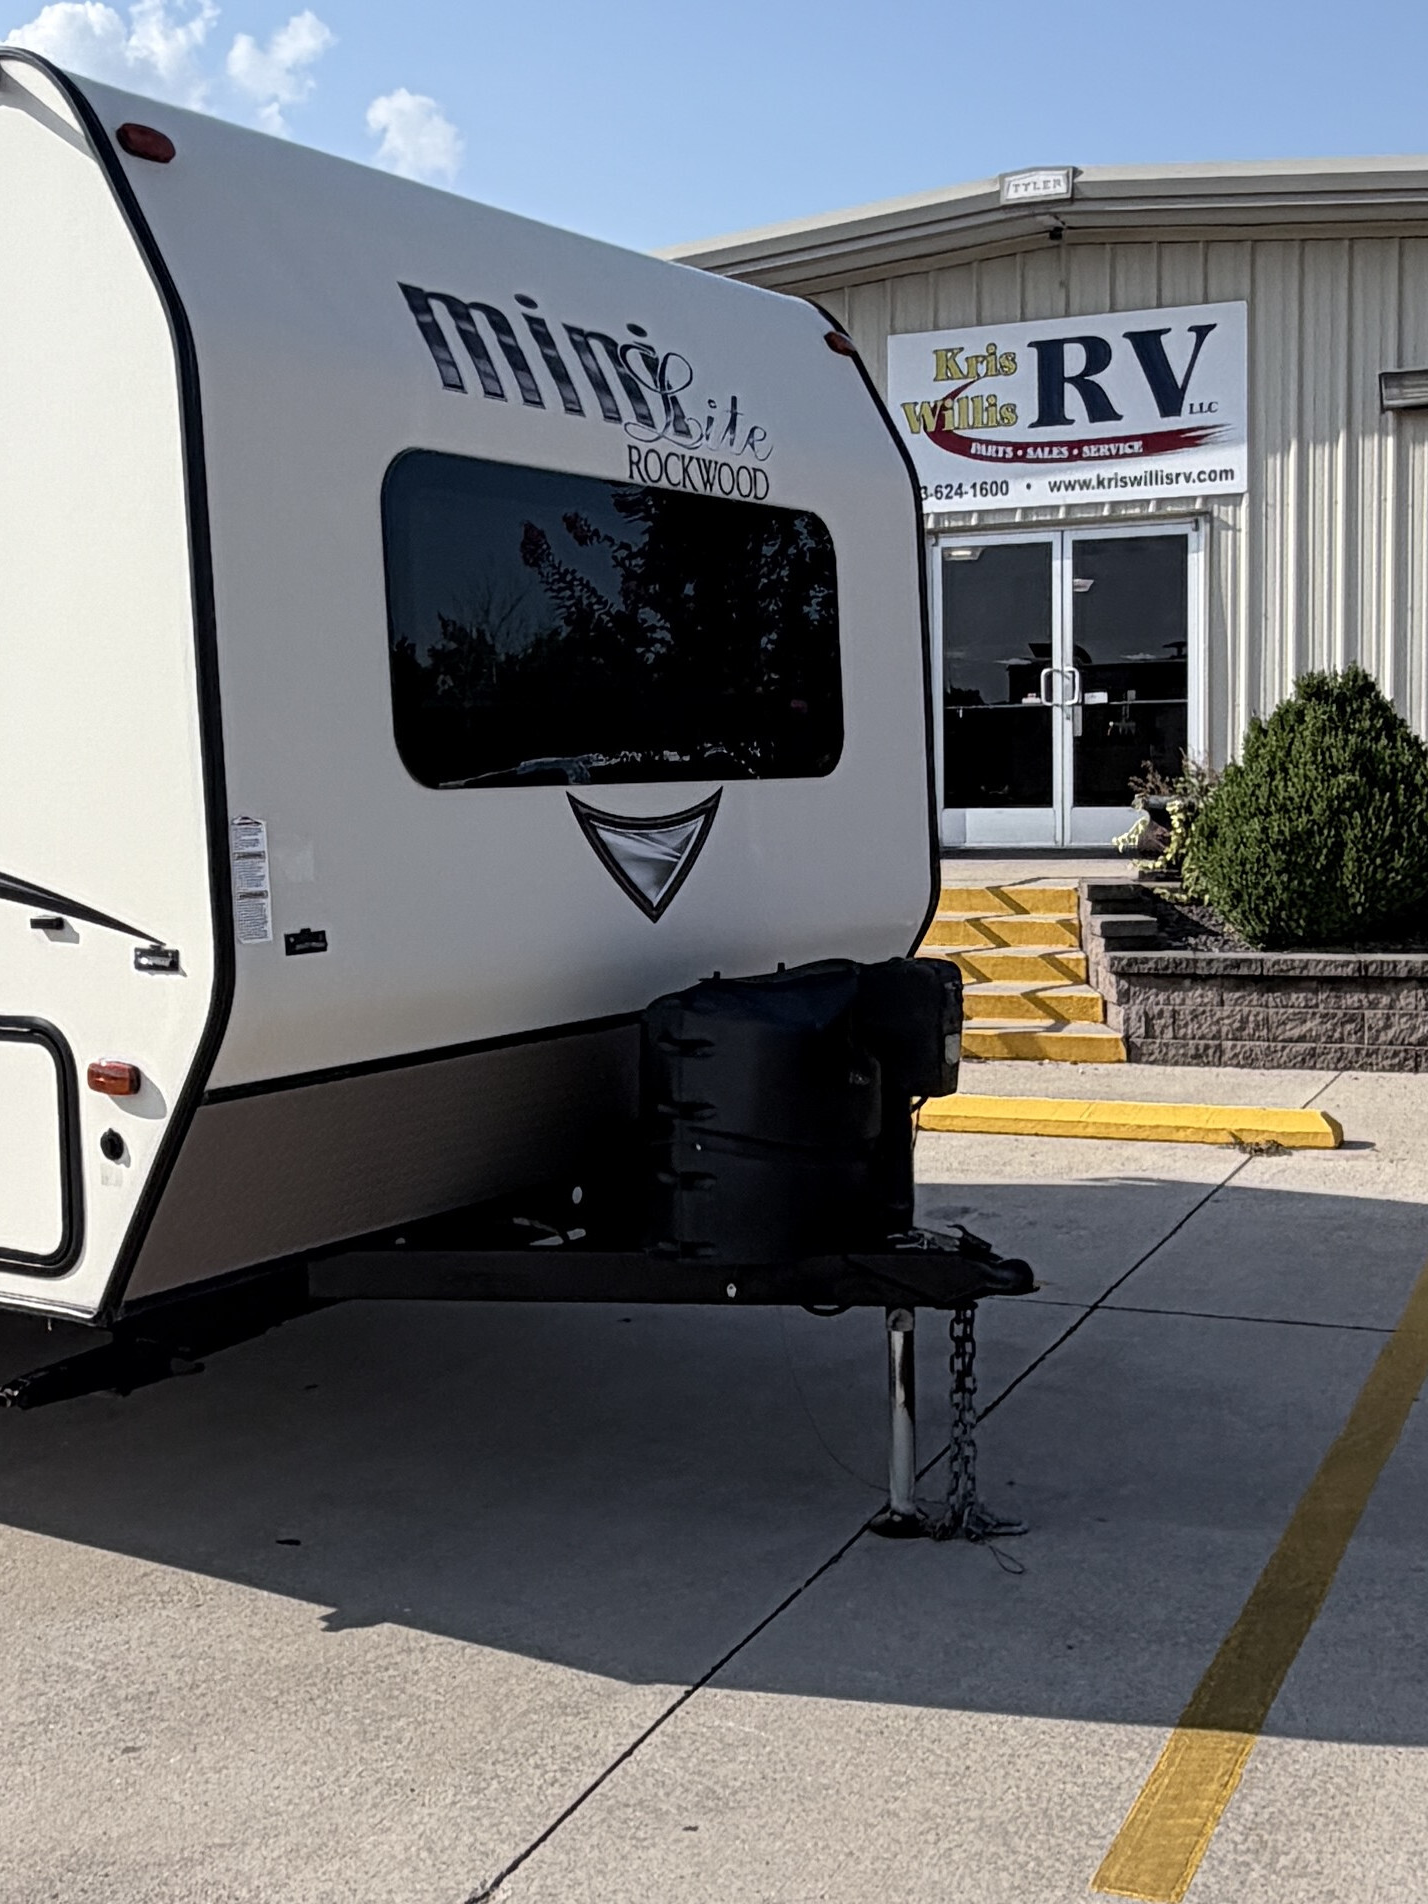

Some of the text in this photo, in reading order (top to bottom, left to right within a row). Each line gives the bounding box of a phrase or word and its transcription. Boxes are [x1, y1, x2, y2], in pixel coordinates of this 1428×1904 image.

[1012, 179, 1062, 193] TYLER
[397, 281, 773, 461] mini Lite
[933, 342, 1018, 382] Kris
[1027, 323, 1219, 429] RV LLC
[900, 394, 1018, 434] Willis
[970, 440, 1143, 459] PARTS SALES SERVICE
[627, 444, 770, 501] ROCKWOOD
[1048, 467, 1235, 493] www.kriswillisrv.com
